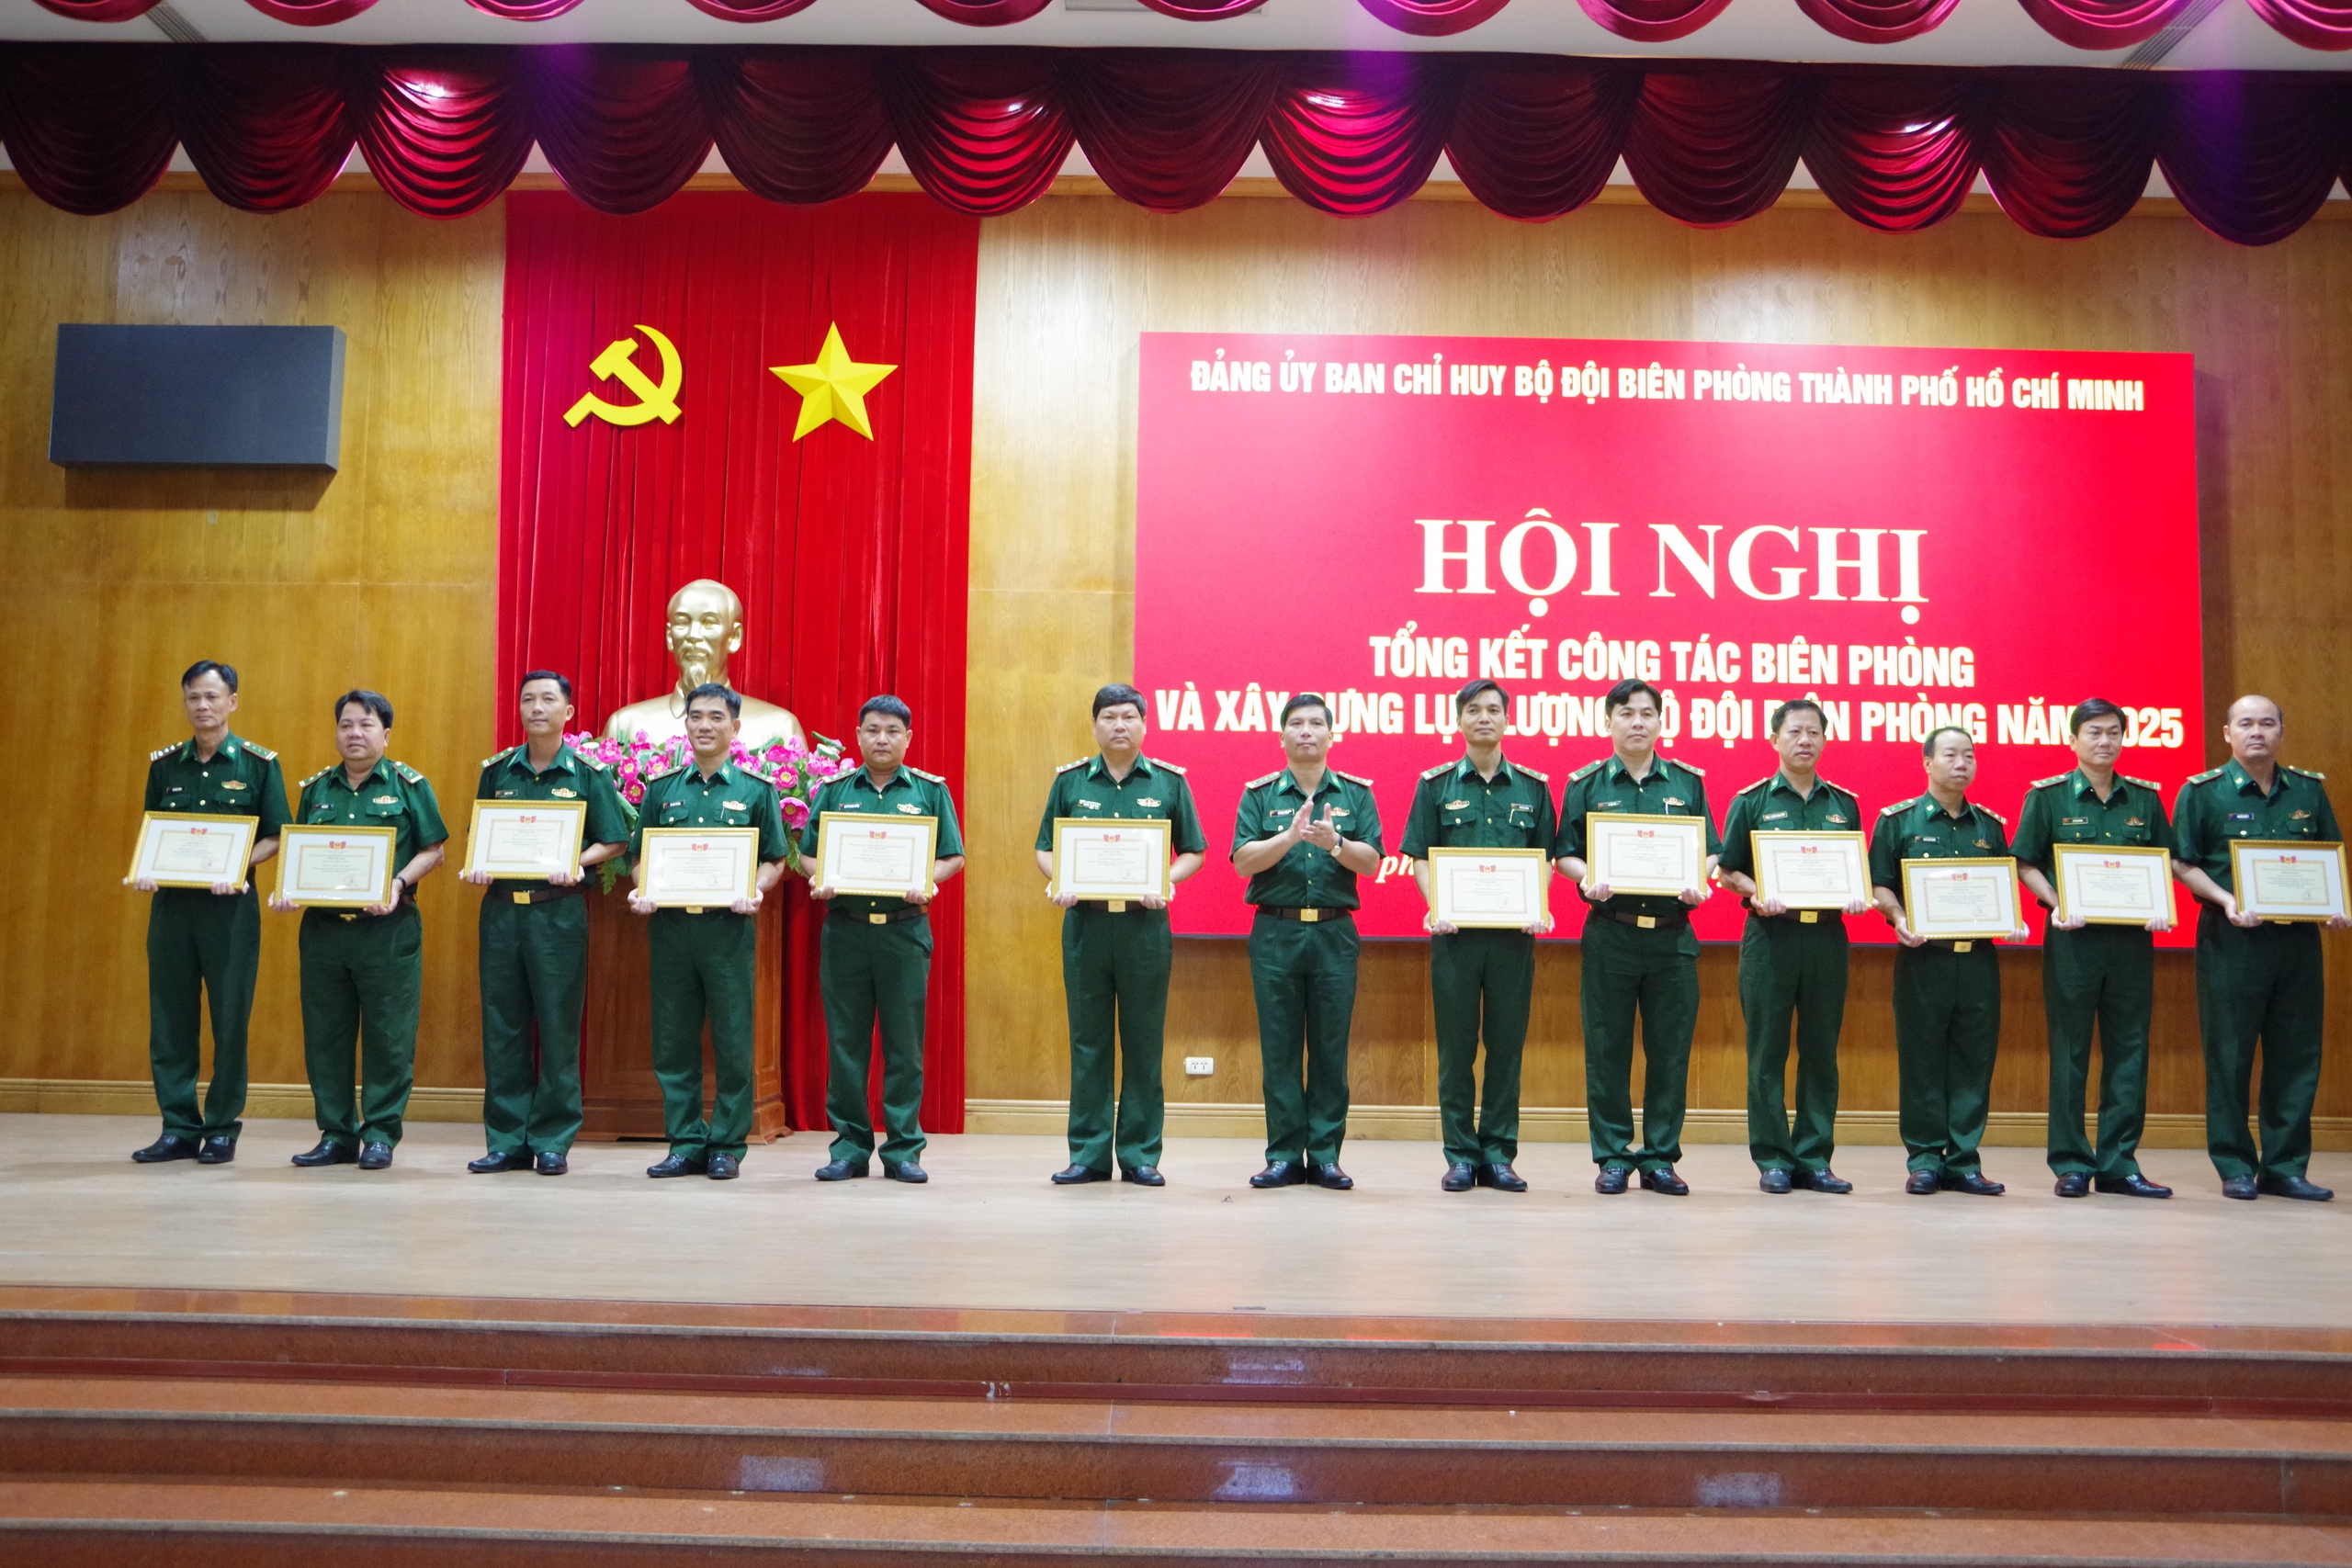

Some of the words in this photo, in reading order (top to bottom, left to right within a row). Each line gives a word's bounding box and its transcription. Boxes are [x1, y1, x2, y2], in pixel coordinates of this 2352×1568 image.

[1190, 348, 1272, 392] ĐẢNG
[1279, 349, 1317, 393] ỦY
[1325, 362, 1385, 394] BAN
[1393, 353, 1442, 395] CHỈ
[1451, 365, 1507, 396] HUY
[1515, 359, 1553, 403] BỘ
[1561, 359, 1610, 405] ĐỘI
[1619, 362, 1685, 400] BIÊN
[1693, 363, 1792, 402] PHÒNG
[1798, 366, 1893, 405] THÀNH
[1901, 365, 1959, 406] PHỐ
[1966, 367, 2005, 408] HỒ
[2012, 372, 2060, 410] CHÍ
[2067, 378, 2144, 412] MINH
[1413, 507, 1621, 617] HỘI
[1648, 523, 1929, 626] NGHỊ
[1369, 620, 1468, 678] TỔNG
[1479, 624, 1548, 680] KẾT
[1557, 630, 1660, 682] CÔNG
[1670, 633, 1741, 683] TÁC
[1751, 635, 1838, 684] BIÊN
[1849, 636, 1974, 688] PHÒNG
[1155, 682, 1204, 731] VÀ
[1214, 682, 1290, 732] XÂY
[1300, 688, 1404, 742] ỰNG
[1414, 690, 1463, 744] LỰ
[1690, 690, 1753, 749] ĐỘI
[1860, 693, 1987, 744] PHÒNG
[2121, 706, 2184, 748] 025
